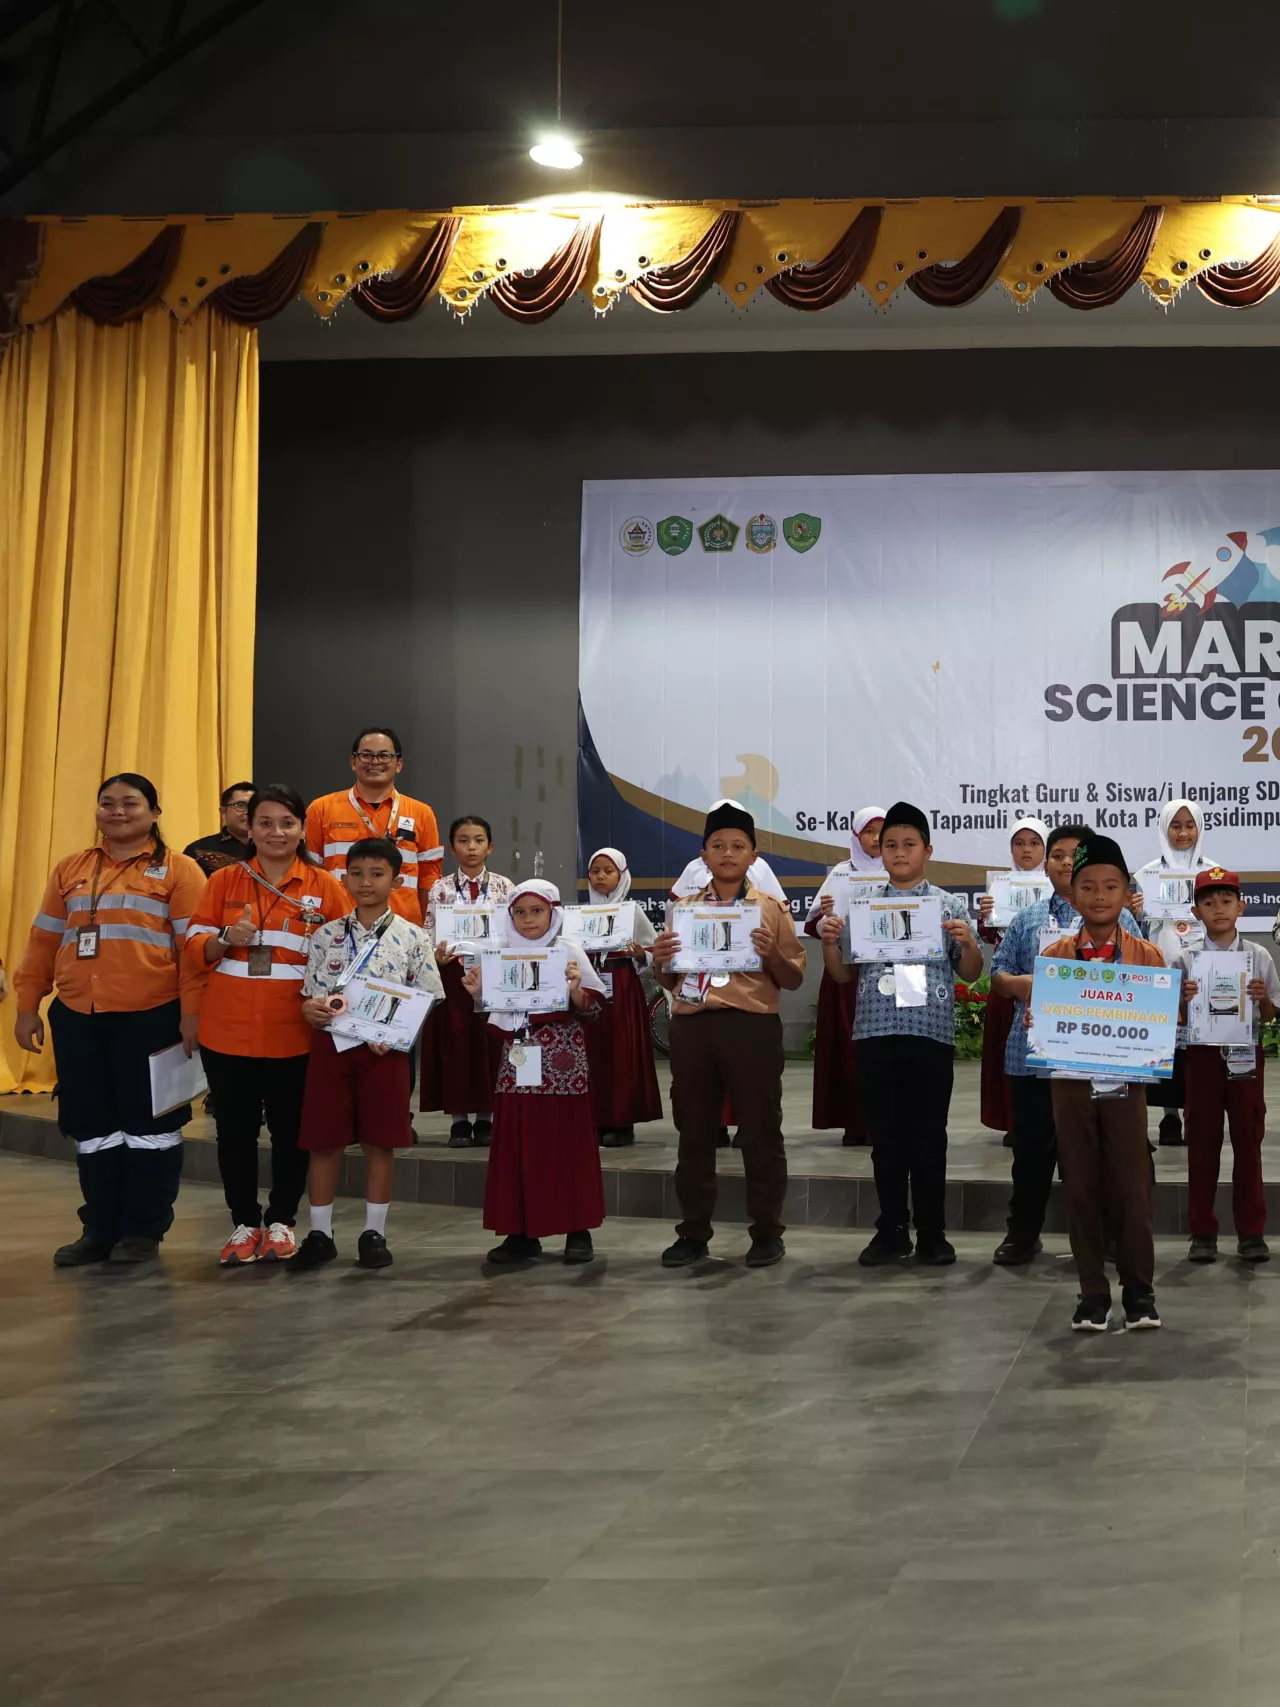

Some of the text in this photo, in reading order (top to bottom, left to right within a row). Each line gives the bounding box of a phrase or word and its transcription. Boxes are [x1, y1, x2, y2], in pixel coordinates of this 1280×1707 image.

[1044, 682, 1266, 722] SCIENCE
[960, 784, 1029, 807] Tingkat
[1036, 783, 1080, 803] Guru
[1086, 782, 1099, 802] &
[1106, 782, 1173, 802] Siswa/i
[930, 809, 1008, 834] Tapanuli
[1096, 808, 1138, 828] Kota
[1132, 974, 1152, 982] POSI
[1080, 989, 1134, 1003] JUARA 3
[1042, 1002, 1169, 1024] UANG PEMBINAAN
[1056, 1021, 1149, 1040] RP 500.000
